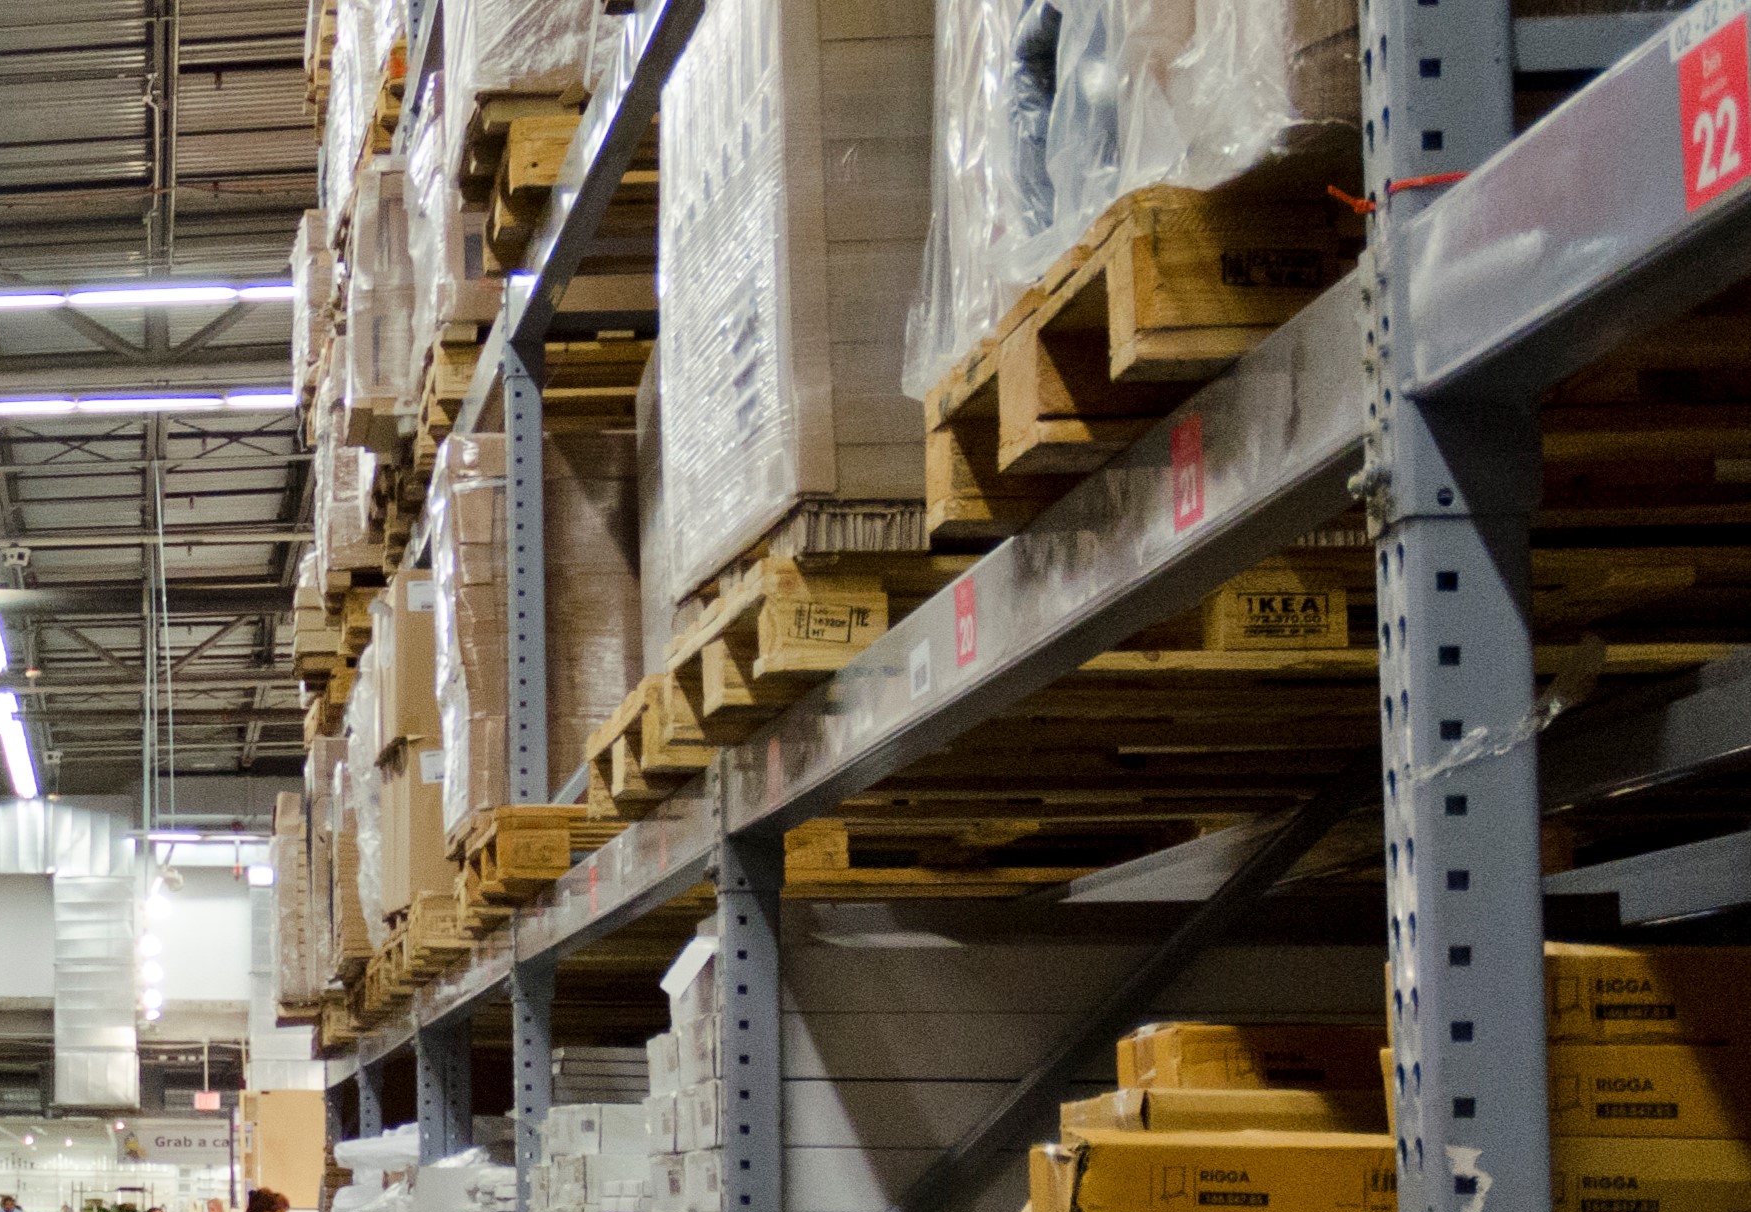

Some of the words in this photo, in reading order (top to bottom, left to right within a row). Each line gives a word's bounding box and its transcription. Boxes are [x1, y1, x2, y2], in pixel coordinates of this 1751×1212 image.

[1693, 96, 1741, 192] 22
[1247, 597, 1320, 612] IKEA
[959, 614, 974, 656] 20
[1596, 978, 1652, 993] RIGGA
[1596, 1077, 1654, 1092] RIGGA
[154, 1135, 193, 1148] Grab
[197, 1139, 207, 1148] a
[1200, 1169, 1250, 1183] RIGGA
[1582, 1175, 1639, 1190] RIGGA
